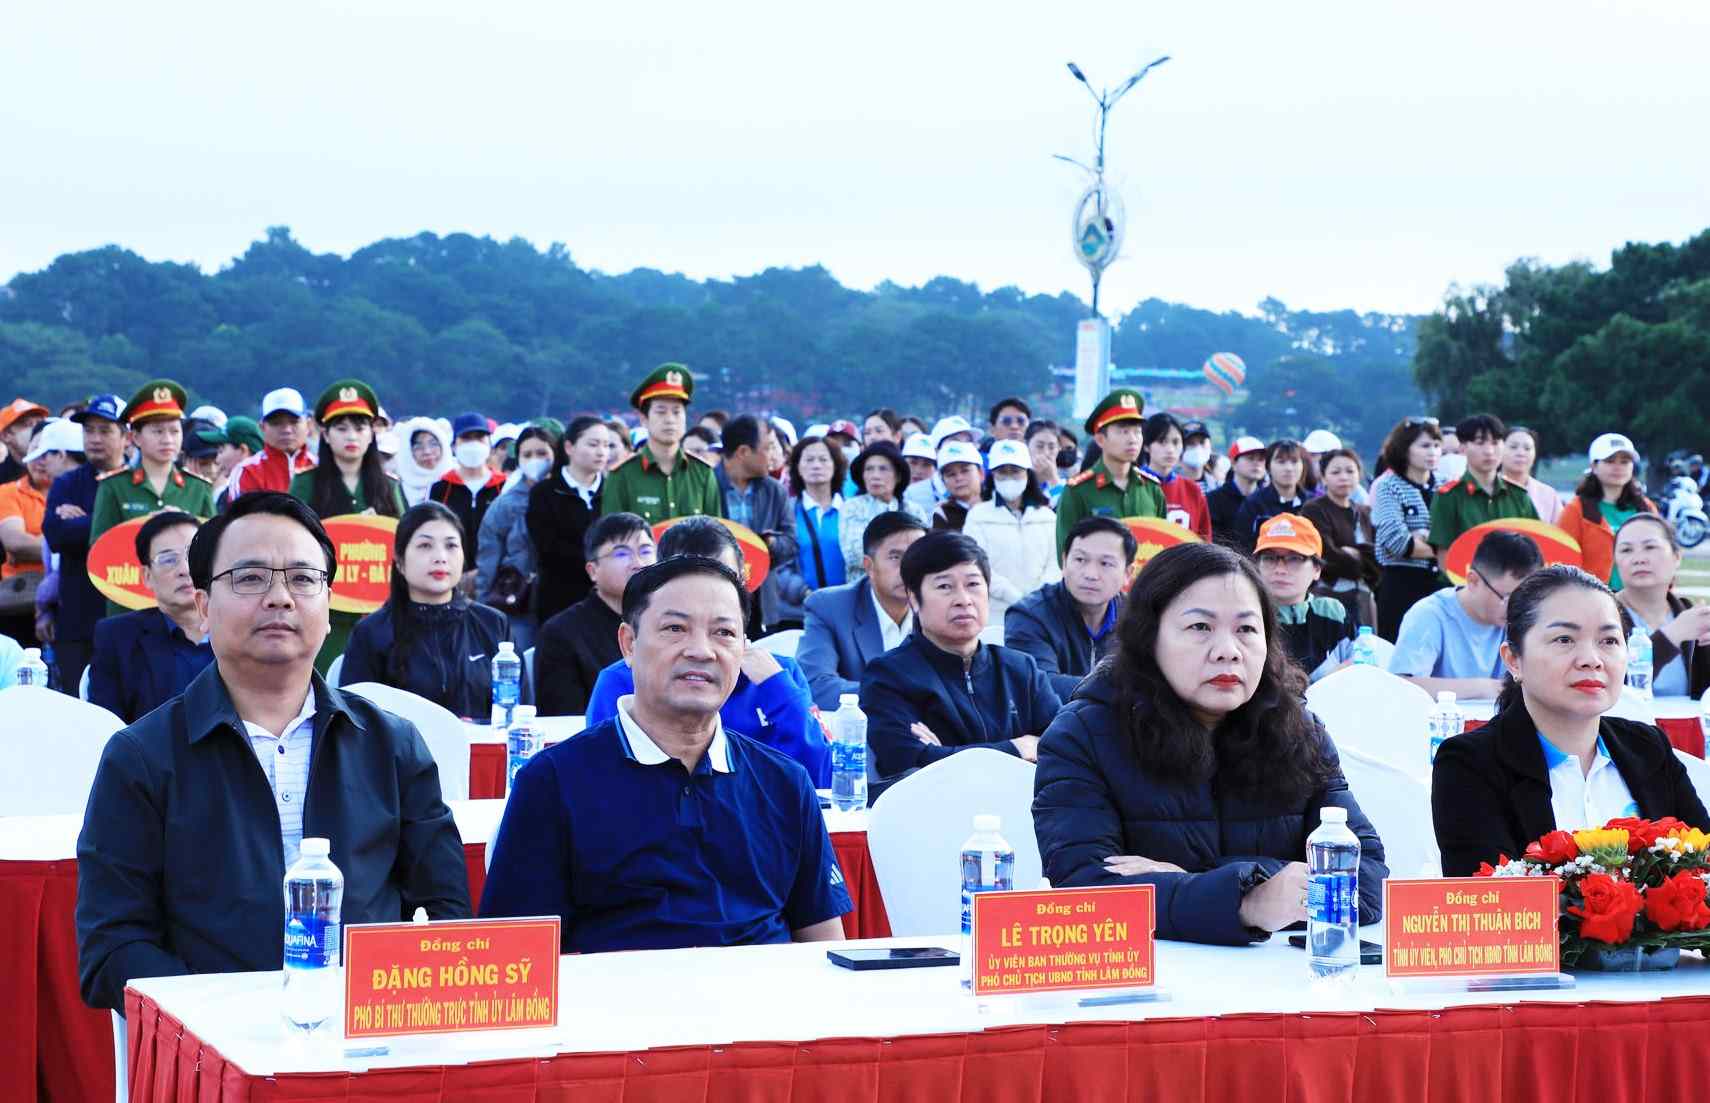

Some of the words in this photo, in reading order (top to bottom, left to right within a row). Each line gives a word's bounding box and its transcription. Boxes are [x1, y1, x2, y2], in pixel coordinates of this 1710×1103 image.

[106, 562, 140, 585] XUÂN
[346, 564, 360, 583] LY
[1036, 902, 1072, 915] Đồng
[1076, 901, 1096, 913] chí
[1445, 891, 1477, 906] Đồng
[1481, 890, 1499, 904] chí
[1402, 906, 1448, 933] NGUYỄN
[1451, 914, 1470, 936] THỊ
[1473, 909, 1511, 934] THUẬN
[1515, 907, 1541, 931] BÍCH
[420, 938, 461, 952] Đồng
[466, 937, 490, 950] chí
[1001, 922, 1023, 947] LÊ
[1029, 923, 1087, 948] TRỌNG
[1093, 918, 1128, 942] YÊN
[1003, 953, 1025, 968] VIÊN
[1028, 954, 1047, 967] BAN
[1050, 951, 1086, 967] THƯỜNG
[1088, 952, 1100, 966] VỤ
[1103, 948, 1124, 963] TỈNH
[372, 964, 432, 995] ĐẶNG
[439, 956, 499, 987] HỒNG
[505, 958, 532, 984] SỸ
[981, 972, 1000, 987] PHÓ
[1003, 969, 1021, 985] CHỦ
[1024, 970, 1045, 987] TỊCH
[1048, 970, 1073, 983] UBND
[1076, 967, 1097, 982] TỈNH
[1099, 966, 1120, 980] LÂM
[1122, 963, 1148, 979] ĐỒNG
[354, 999, 372, 1030] PHÓ
[375, 998, 384, 1029] BÍ
[386, 999, 406, 1029] THƯ
[406, 996, 441, 1027] THƯỜNG
[443, 998, 466, 1030] TRỰC
[469, 992, 489, 1024] TỈNH
[505, 992, 524, 1021] LÂM
[526, 987, 550, 1021] ĐỒNG
